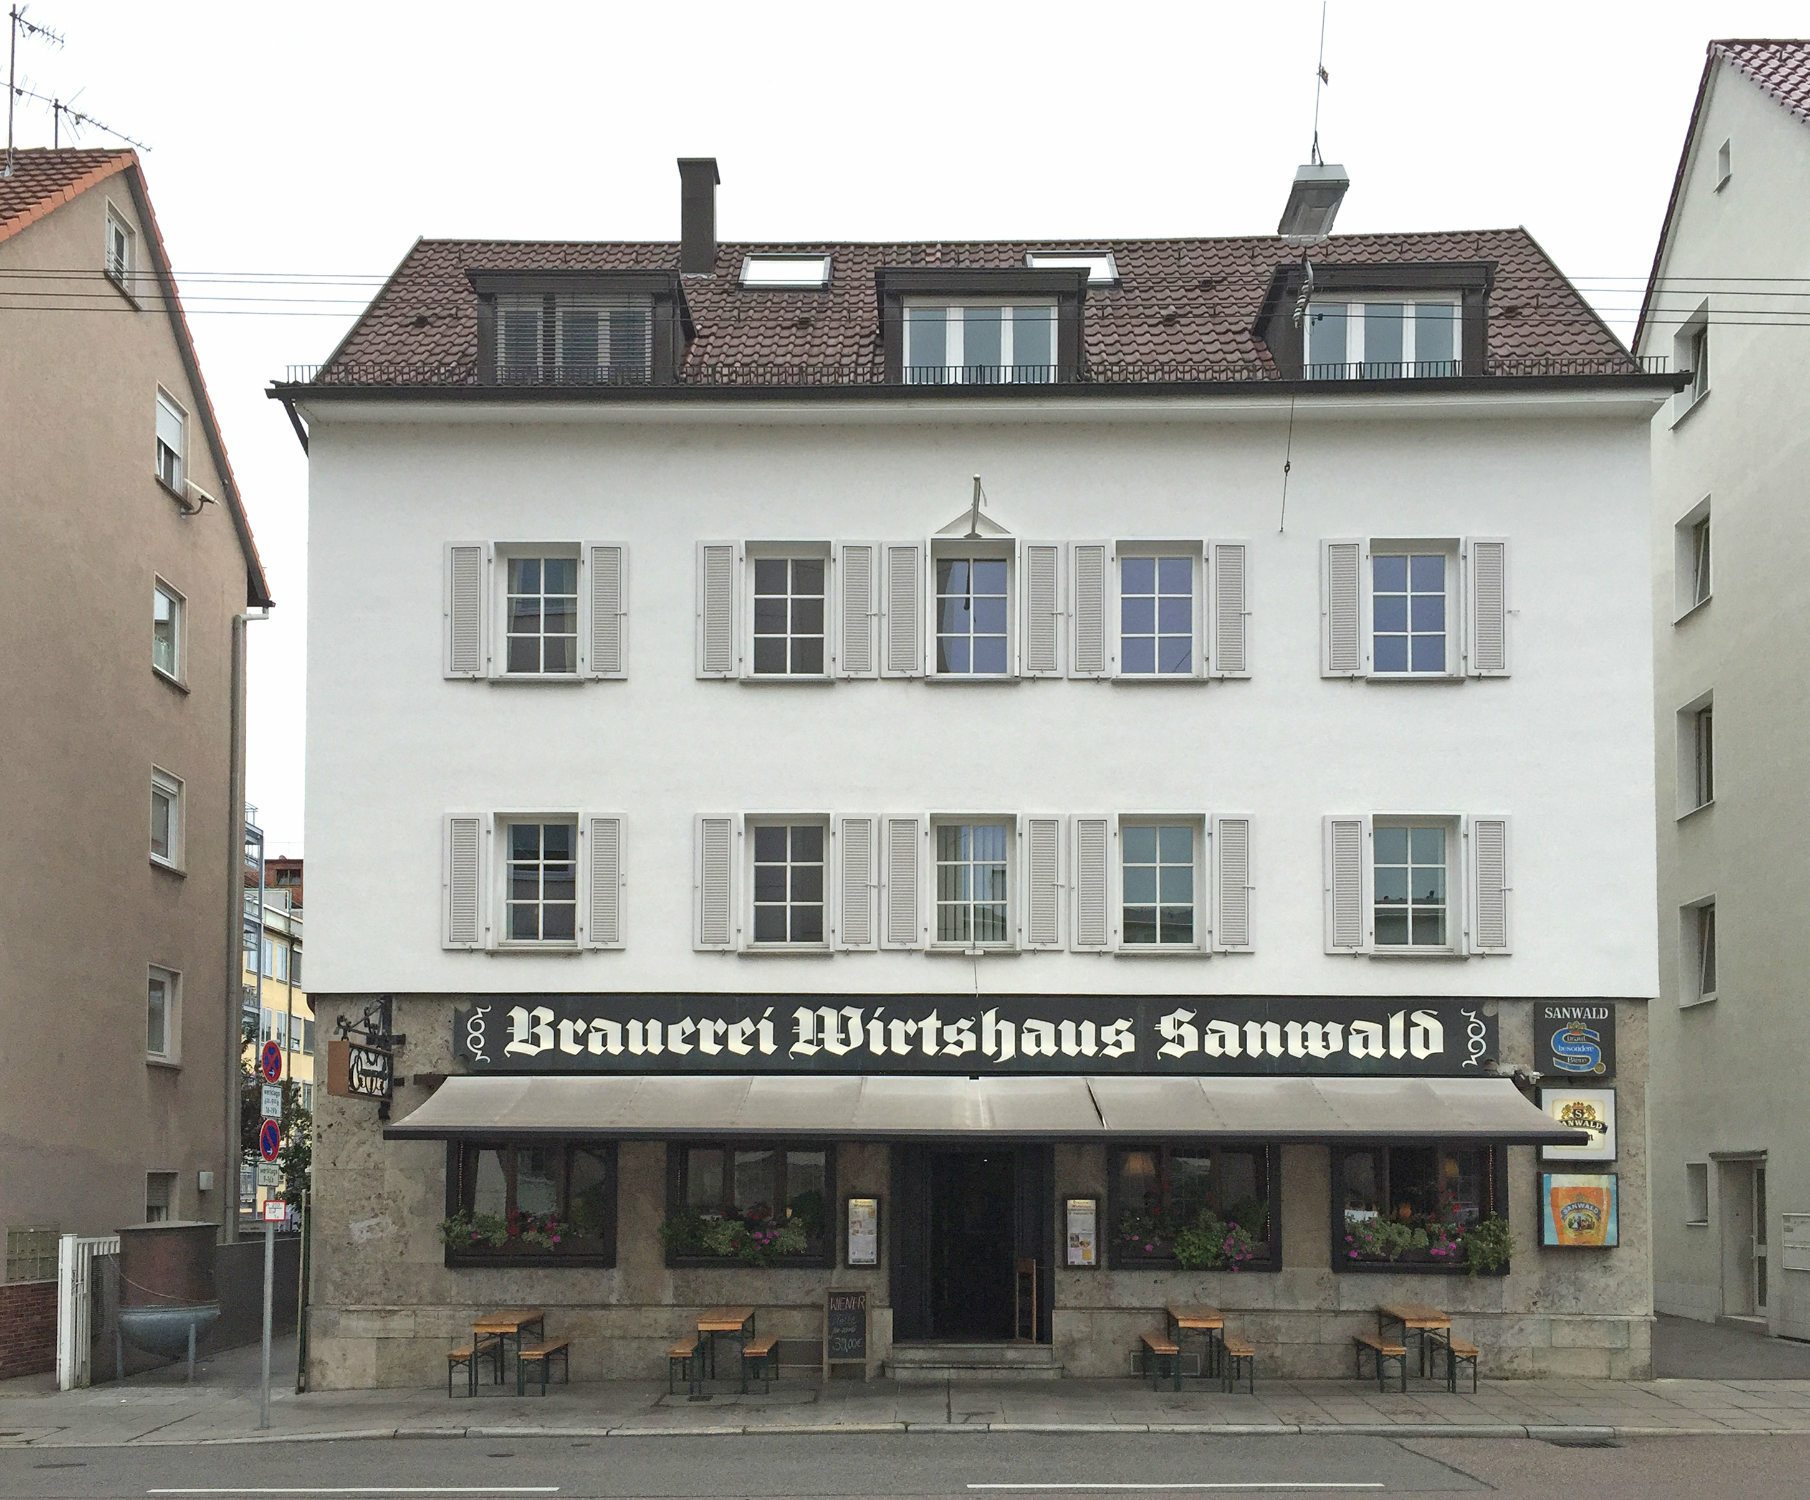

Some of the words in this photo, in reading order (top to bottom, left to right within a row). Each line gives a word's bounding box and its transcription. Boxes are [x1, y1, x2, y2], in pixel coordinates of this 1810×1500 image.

[1545, 1007, 1609, 1020] SANWALD
[504, 1005, 779, 1057] Brauerei
[789, 1005, 1136, 1063] Wirtshaus
[1155, 1007, 1444, 1061] Sanwald
[1575, 1109, 1582, 1118] S
[1561, 1119, 1603, 1129] ANWALD
[1562, 1202, 1599, 1215] SANWALD
[830, 1295, 866, 1311] WIENER
